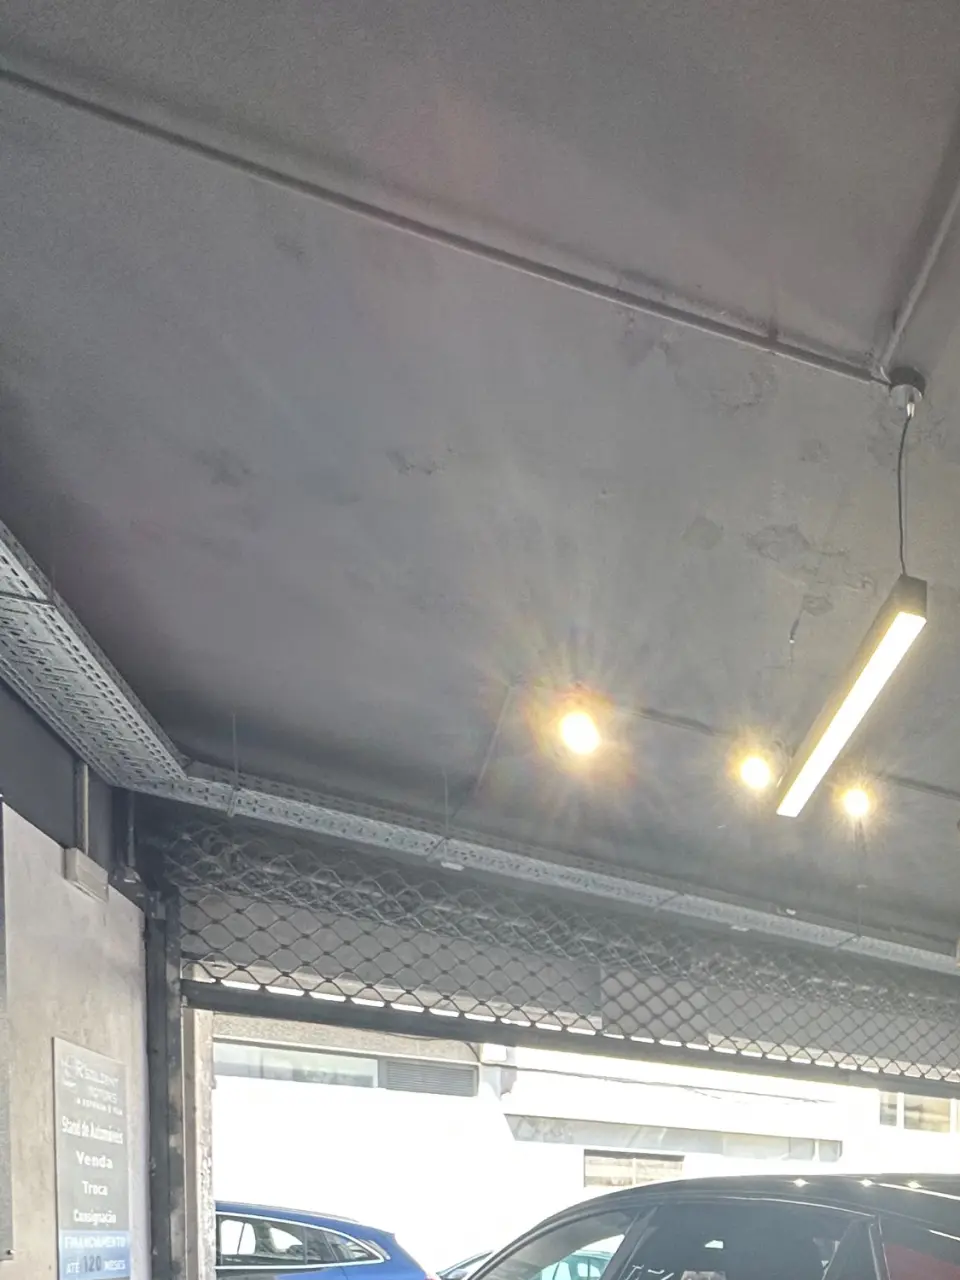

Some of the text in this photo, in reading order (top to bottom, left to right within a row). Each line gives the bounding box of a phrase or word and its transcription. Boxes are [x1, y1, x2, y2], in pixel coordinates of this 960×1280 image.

[75, 1149, 114, 1169] Venda
[81, 1180, 109, 1196] Troca
[83, 1255, 102, 1274] 120
